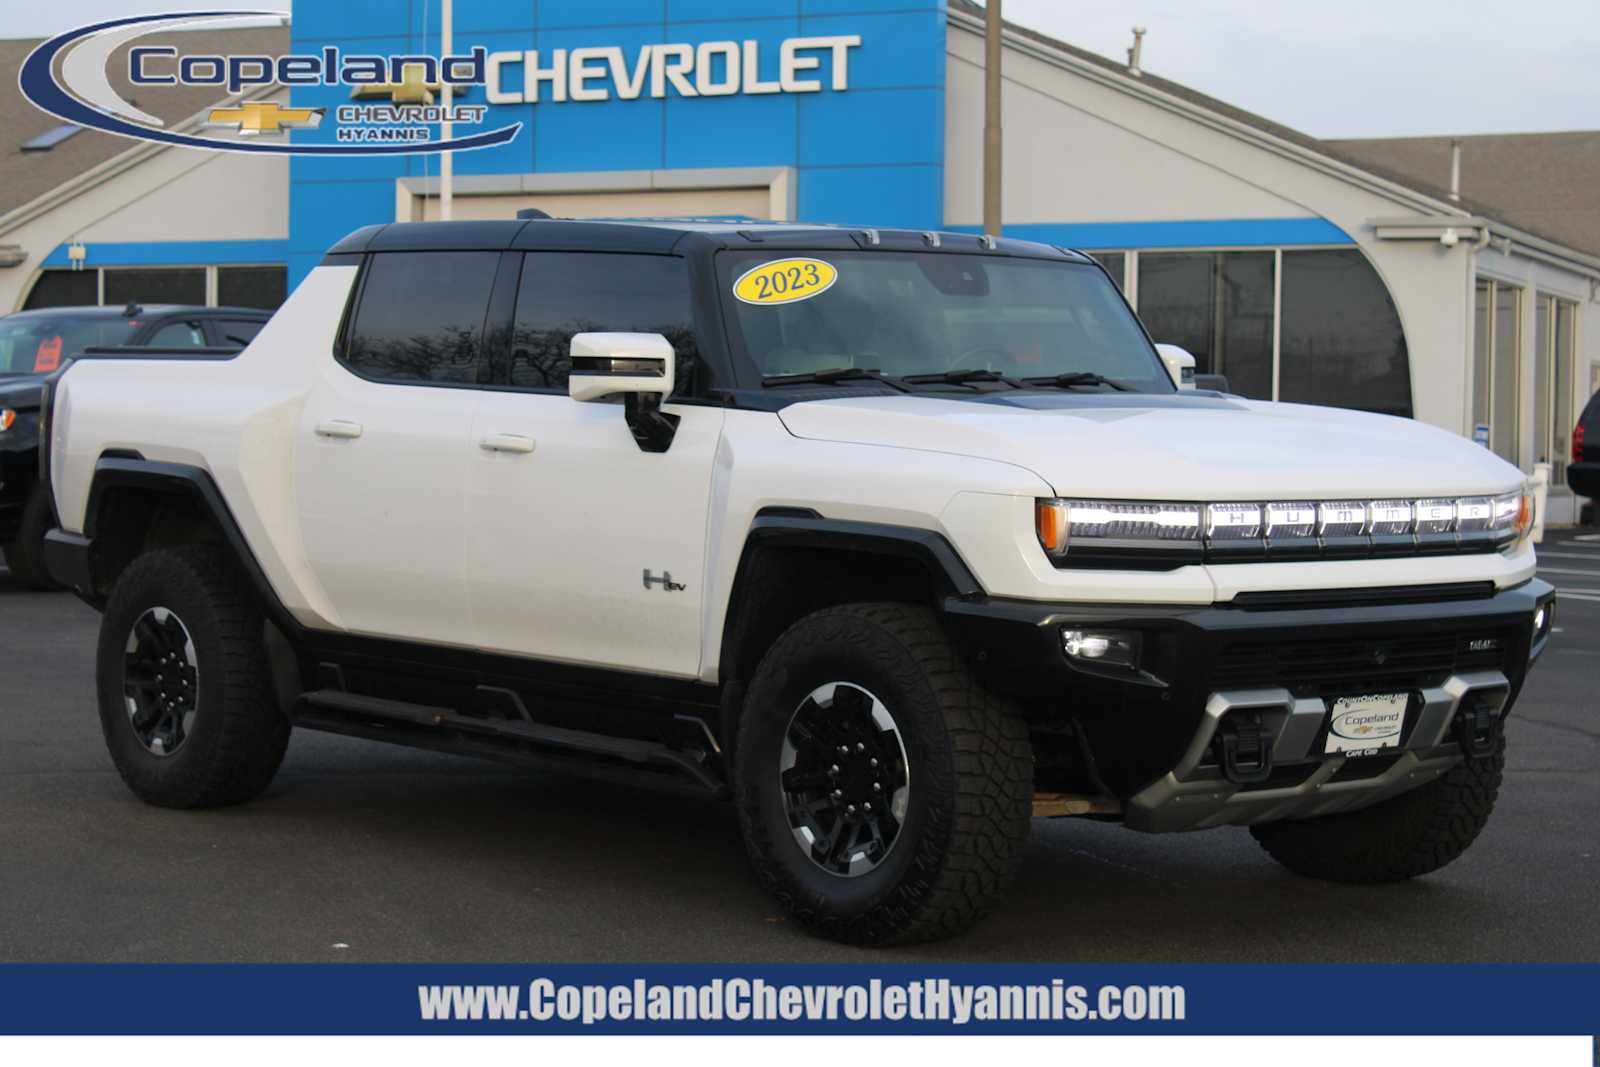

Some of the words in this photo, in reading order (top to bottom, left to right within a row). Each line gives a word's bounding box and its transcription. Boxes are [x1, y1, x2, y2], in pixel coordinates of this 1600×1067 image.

[485, 34, 862, 105] CHEVROLET
[754, 263, 820, 299] 2023
[1229, 507, 1480, 524] HUMMER
[1344, 712, 1400, 726] Copeland
